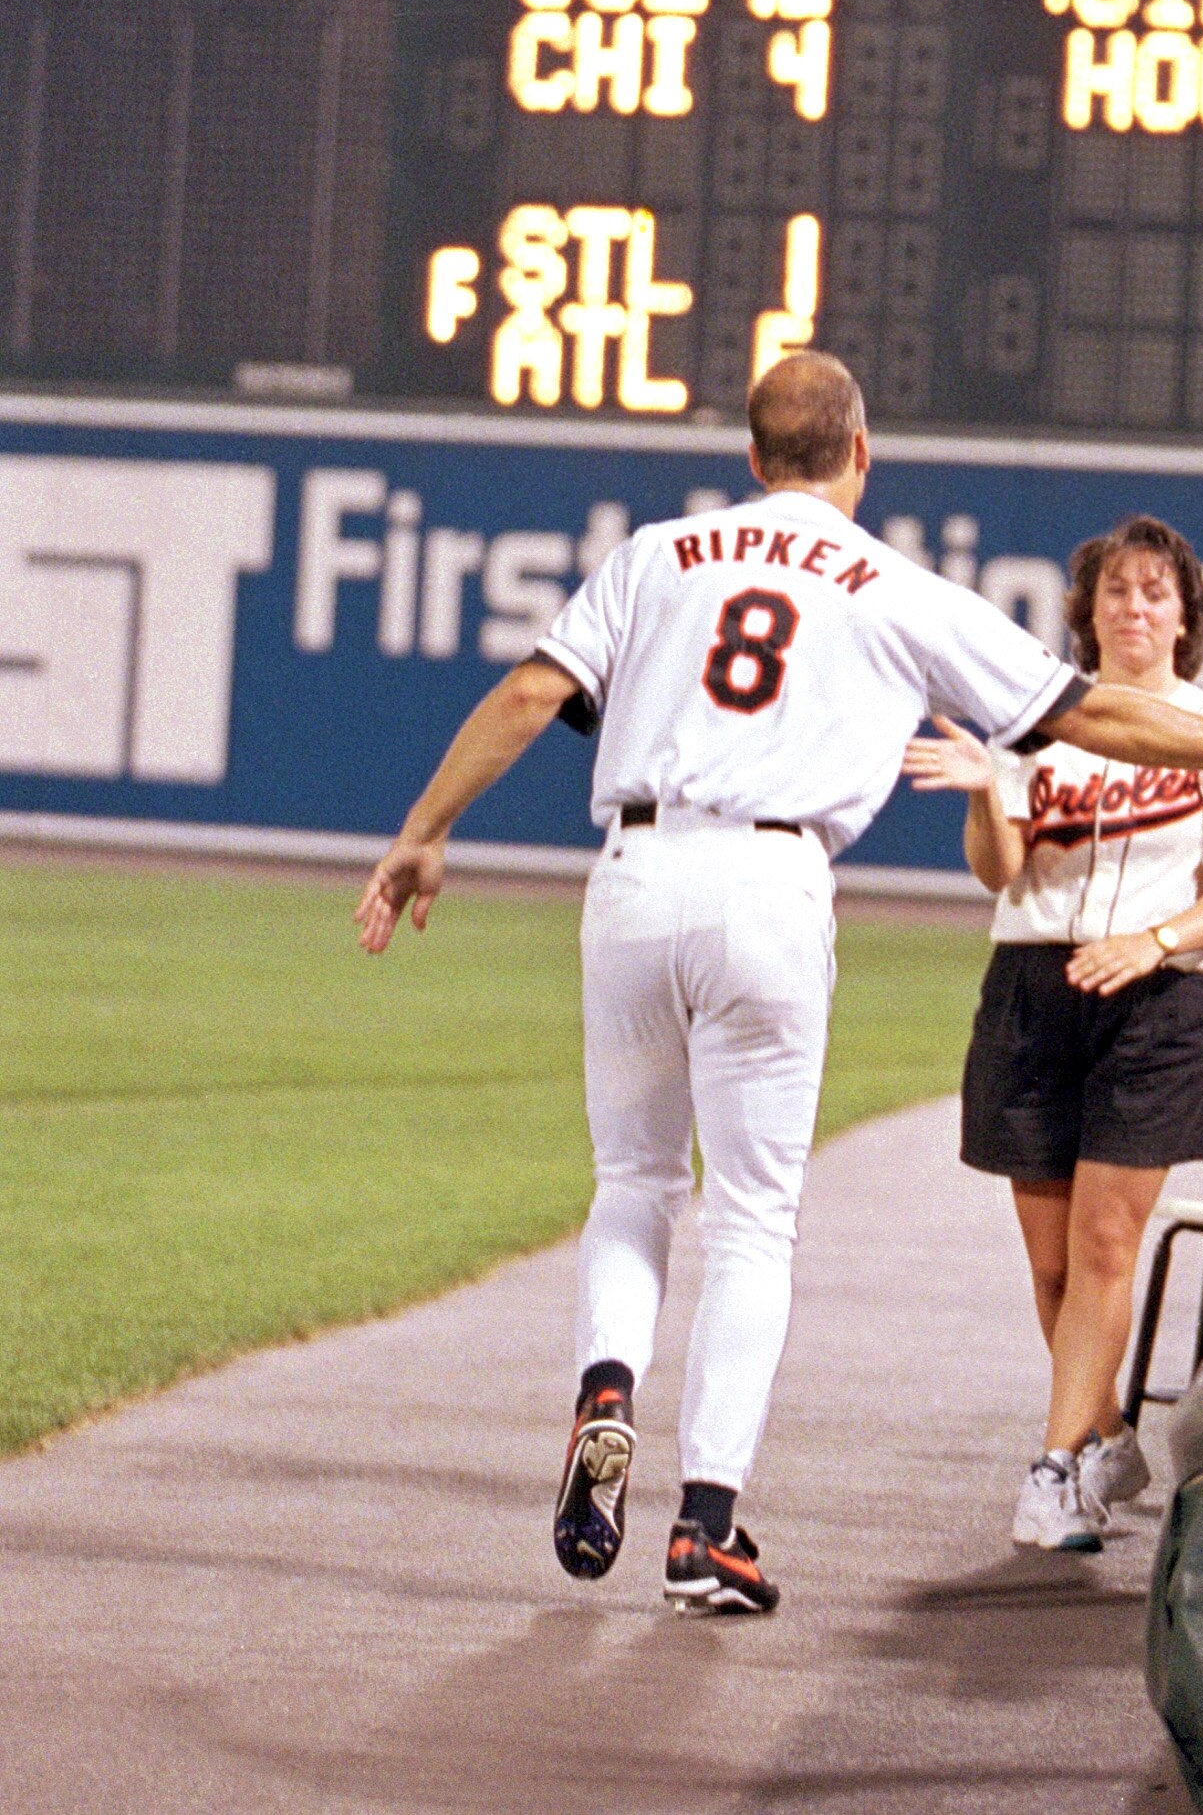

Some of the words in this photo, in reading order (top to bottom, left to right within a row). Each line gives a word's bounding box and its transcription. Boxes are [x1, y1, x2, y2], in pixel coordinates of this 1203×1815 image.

[509, 10, 697, 116] CHI
[769, 18, 831, 120] 4
[428, 247, 480, 343] F
[500, 204, 693, 316] STL
[785, 213, 820, 319] 1
[490, 305, 688, 412] ATL
[673, 526, 881, 597] RIPKEN
[702, 586, 801, 715] 8
